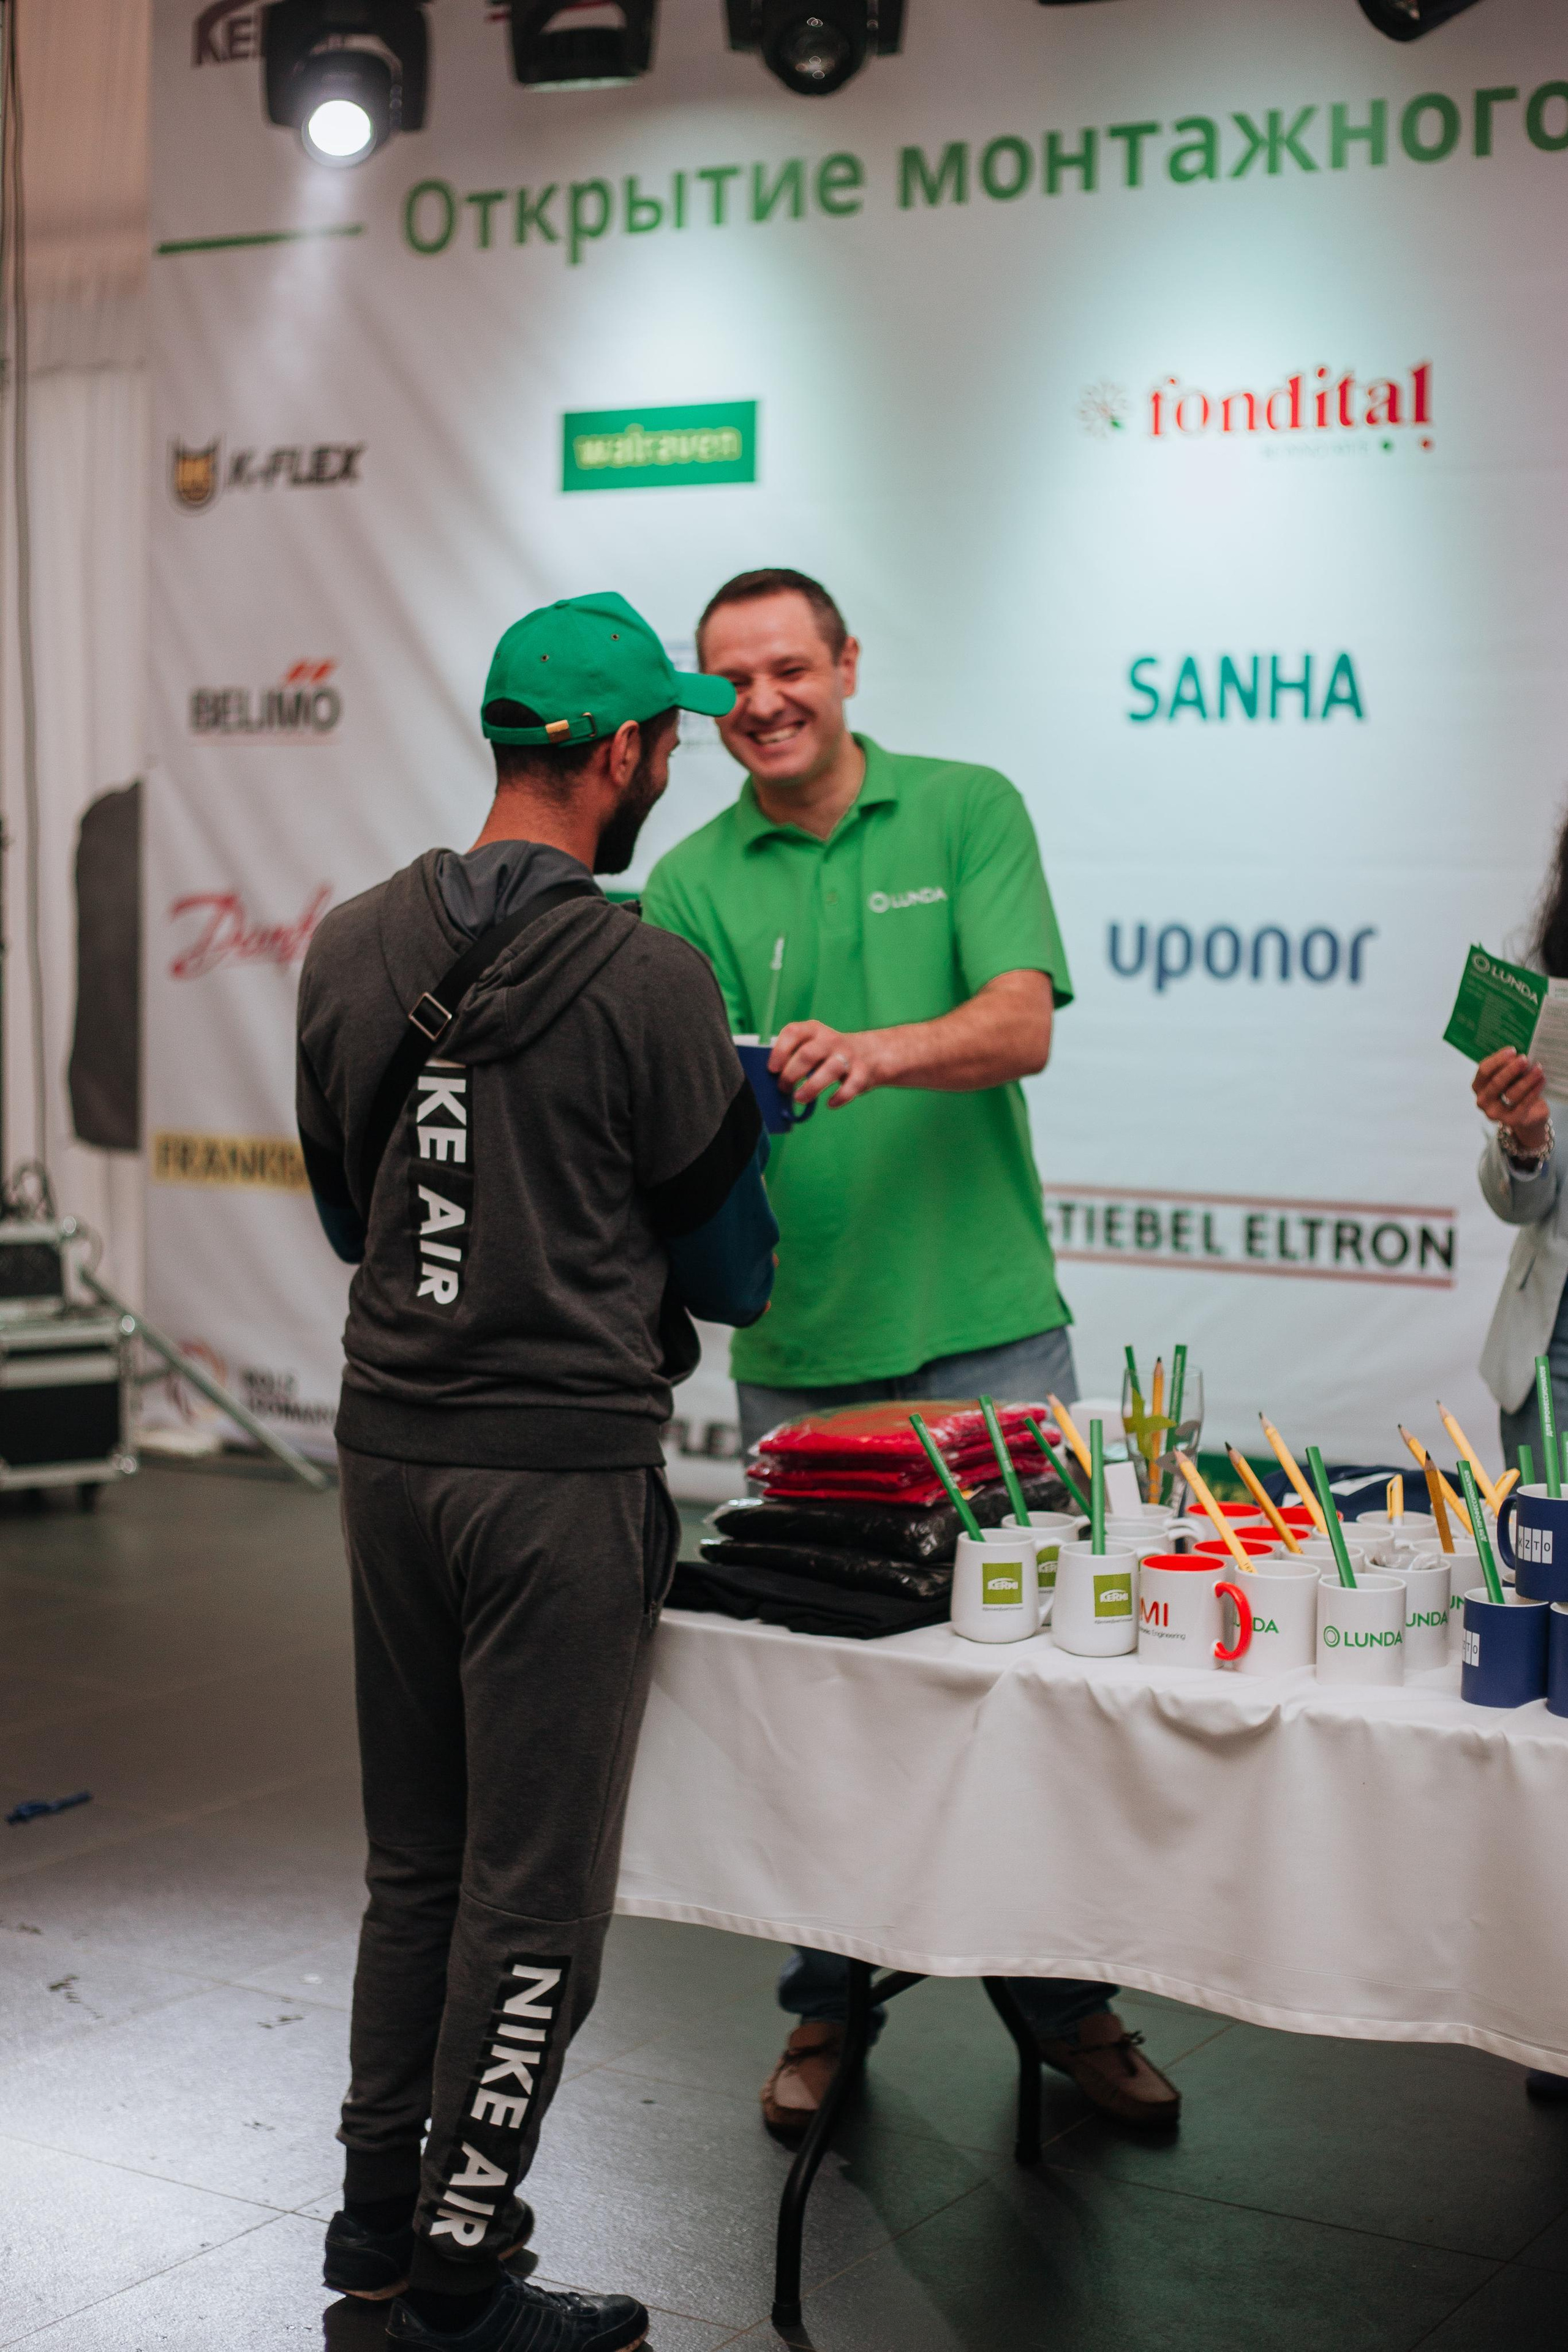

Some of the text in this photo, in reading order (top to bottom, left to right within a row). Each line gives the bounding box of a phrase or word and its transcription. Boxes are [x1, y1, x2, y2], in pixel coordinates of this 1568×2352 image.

[404, 78, 1568, 266] Открытие монтажного
[1148, 360, 1433, 437] fondital
[228, 443, 366, 490] K-FLEX
[191, 685, 341, 734] BELIMO
[1128, 652, 1366, 723] SANHA
[891, 888, 948, 908] LUNDA
[1109, 921, 1376, 993] uponor
[1491, 965, 1538, 1005] LUNDA
[417, 1185, 466, 1305] AIR
[1245, 1212, 1457, 1271] ELTRON
[987, 1577, 1018, 1590] KERMI
[1100, 1589, 1129, 1603] KERMI
[1139, 1595, 1169, 1627] MI
[1344, 1630, 1403, 1648] LUNDA
[429, 1964, 562, 2247] NIKE AIR
